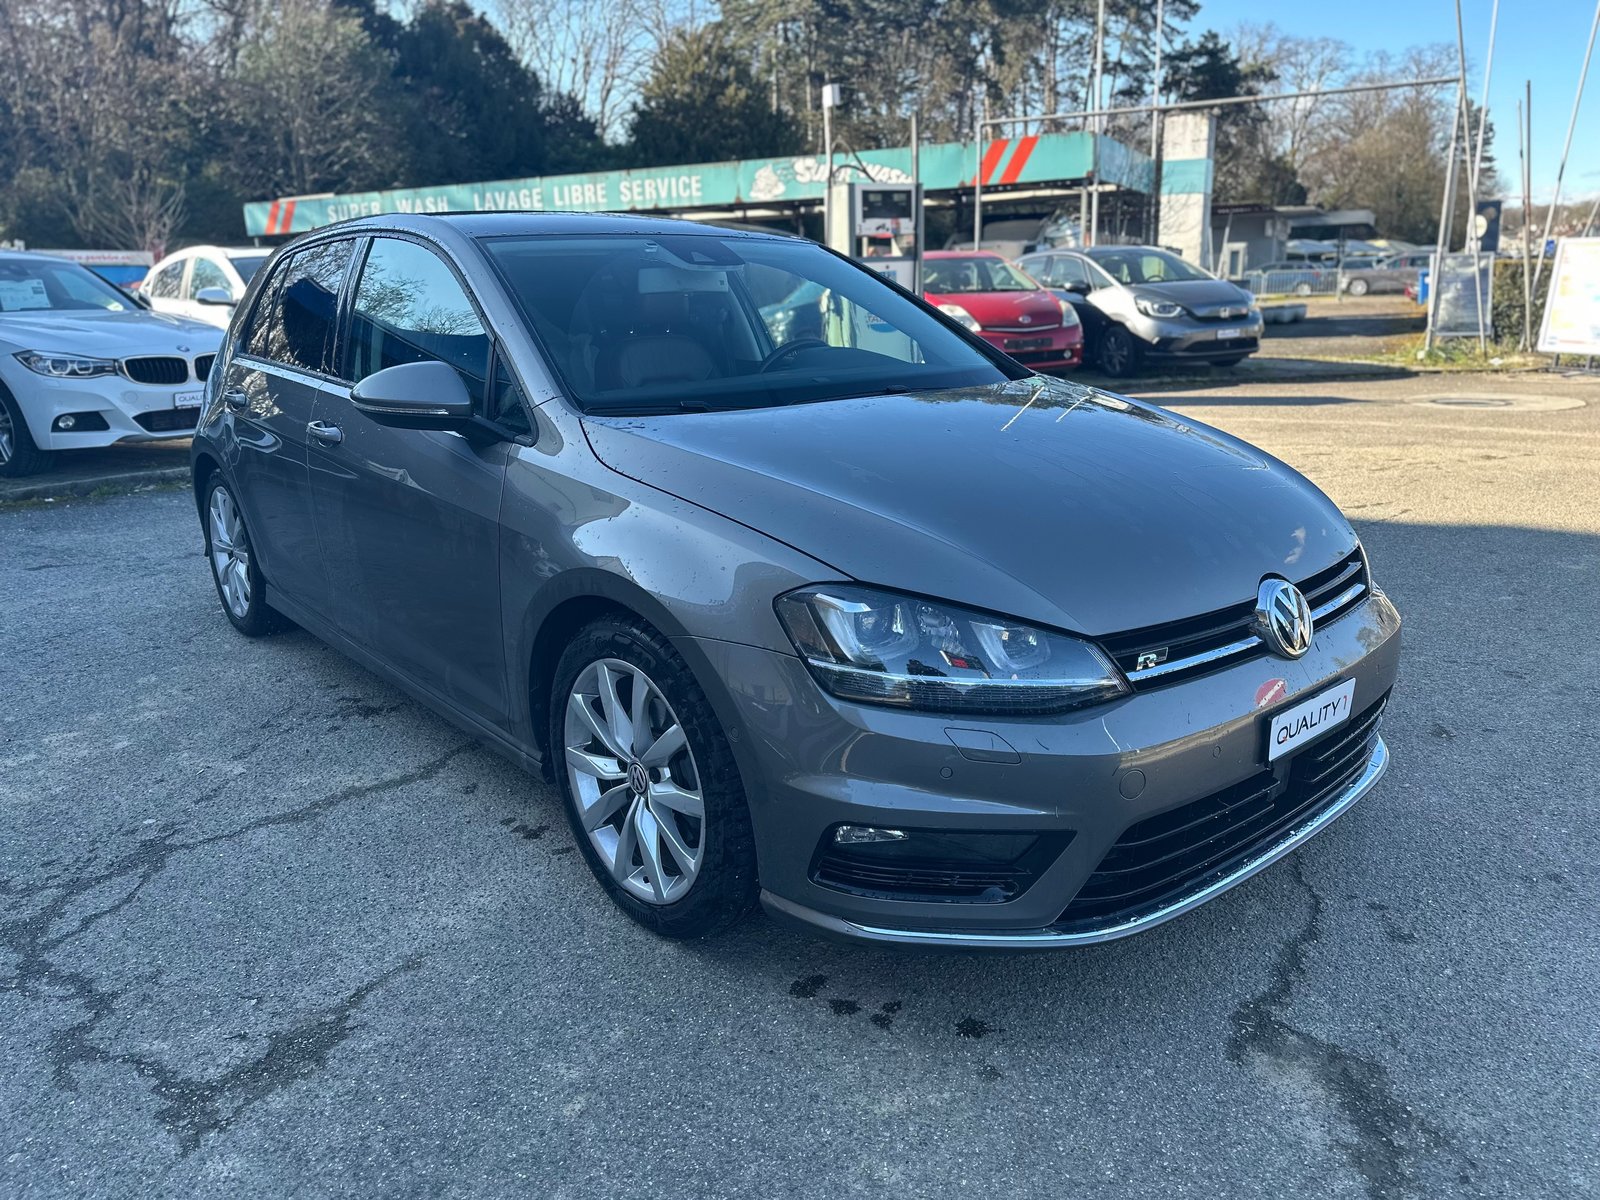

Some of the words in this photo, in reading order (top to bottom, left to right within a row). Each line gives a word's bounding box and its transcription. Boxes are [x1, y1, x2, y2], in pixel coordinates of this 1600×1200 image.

[327, 200, 382, 223] SUPER
[396, 195, 449, 214] WASH
[474, 188, 543, 212] LAVAGE
[553, 182, 608, 207] LIBRE
[619, 175, 703, 203] SERVICE
[1276, 697, 1341, 746] QUALITY
